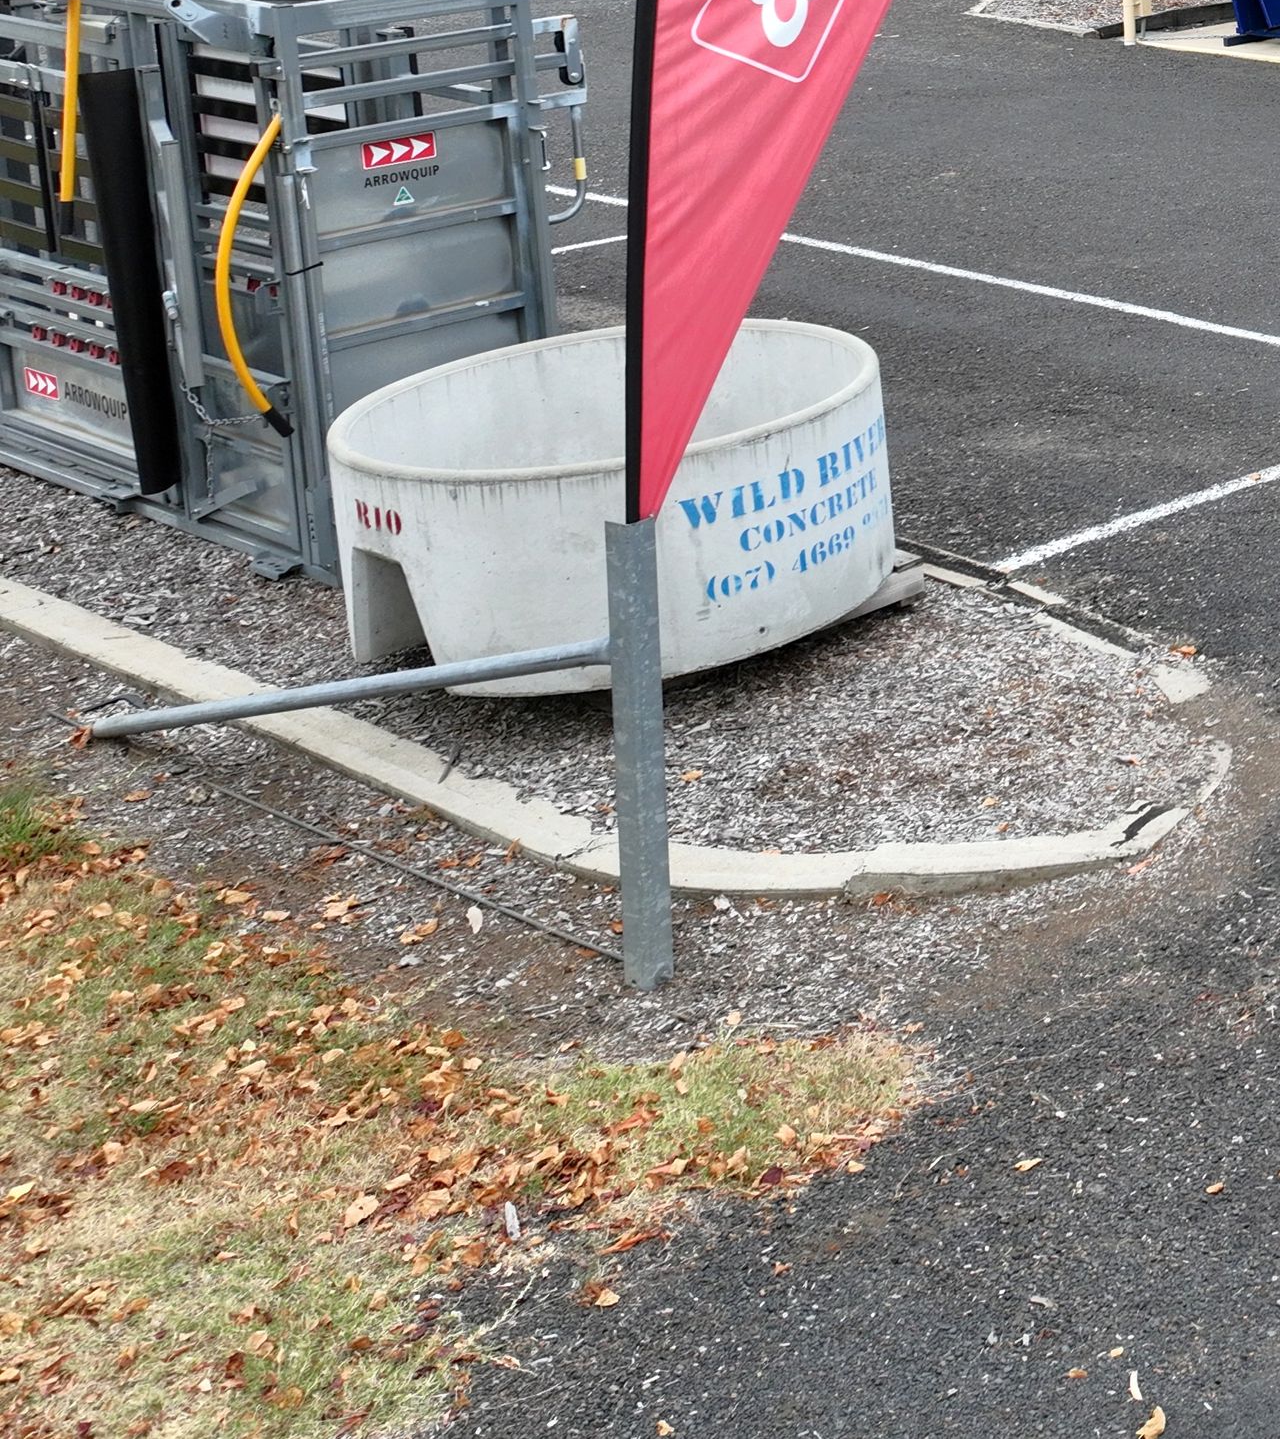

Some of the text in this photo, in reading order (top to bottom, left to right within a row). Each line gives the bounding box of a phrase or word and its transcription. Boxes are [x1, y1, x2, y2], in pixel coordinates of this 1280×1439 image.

[363, 164, 440, 189] ARROWQUIP
[64, 381, 128, 421] ARROWQUIP
[678, 467, 805, 530] WILD
[816, 414, 887, 488] RIVER
[354, 497, 402, 536] RIO
[739, 467, 878, 552] CONCRETE
[706, 525, 856, 602] (07) 4669
